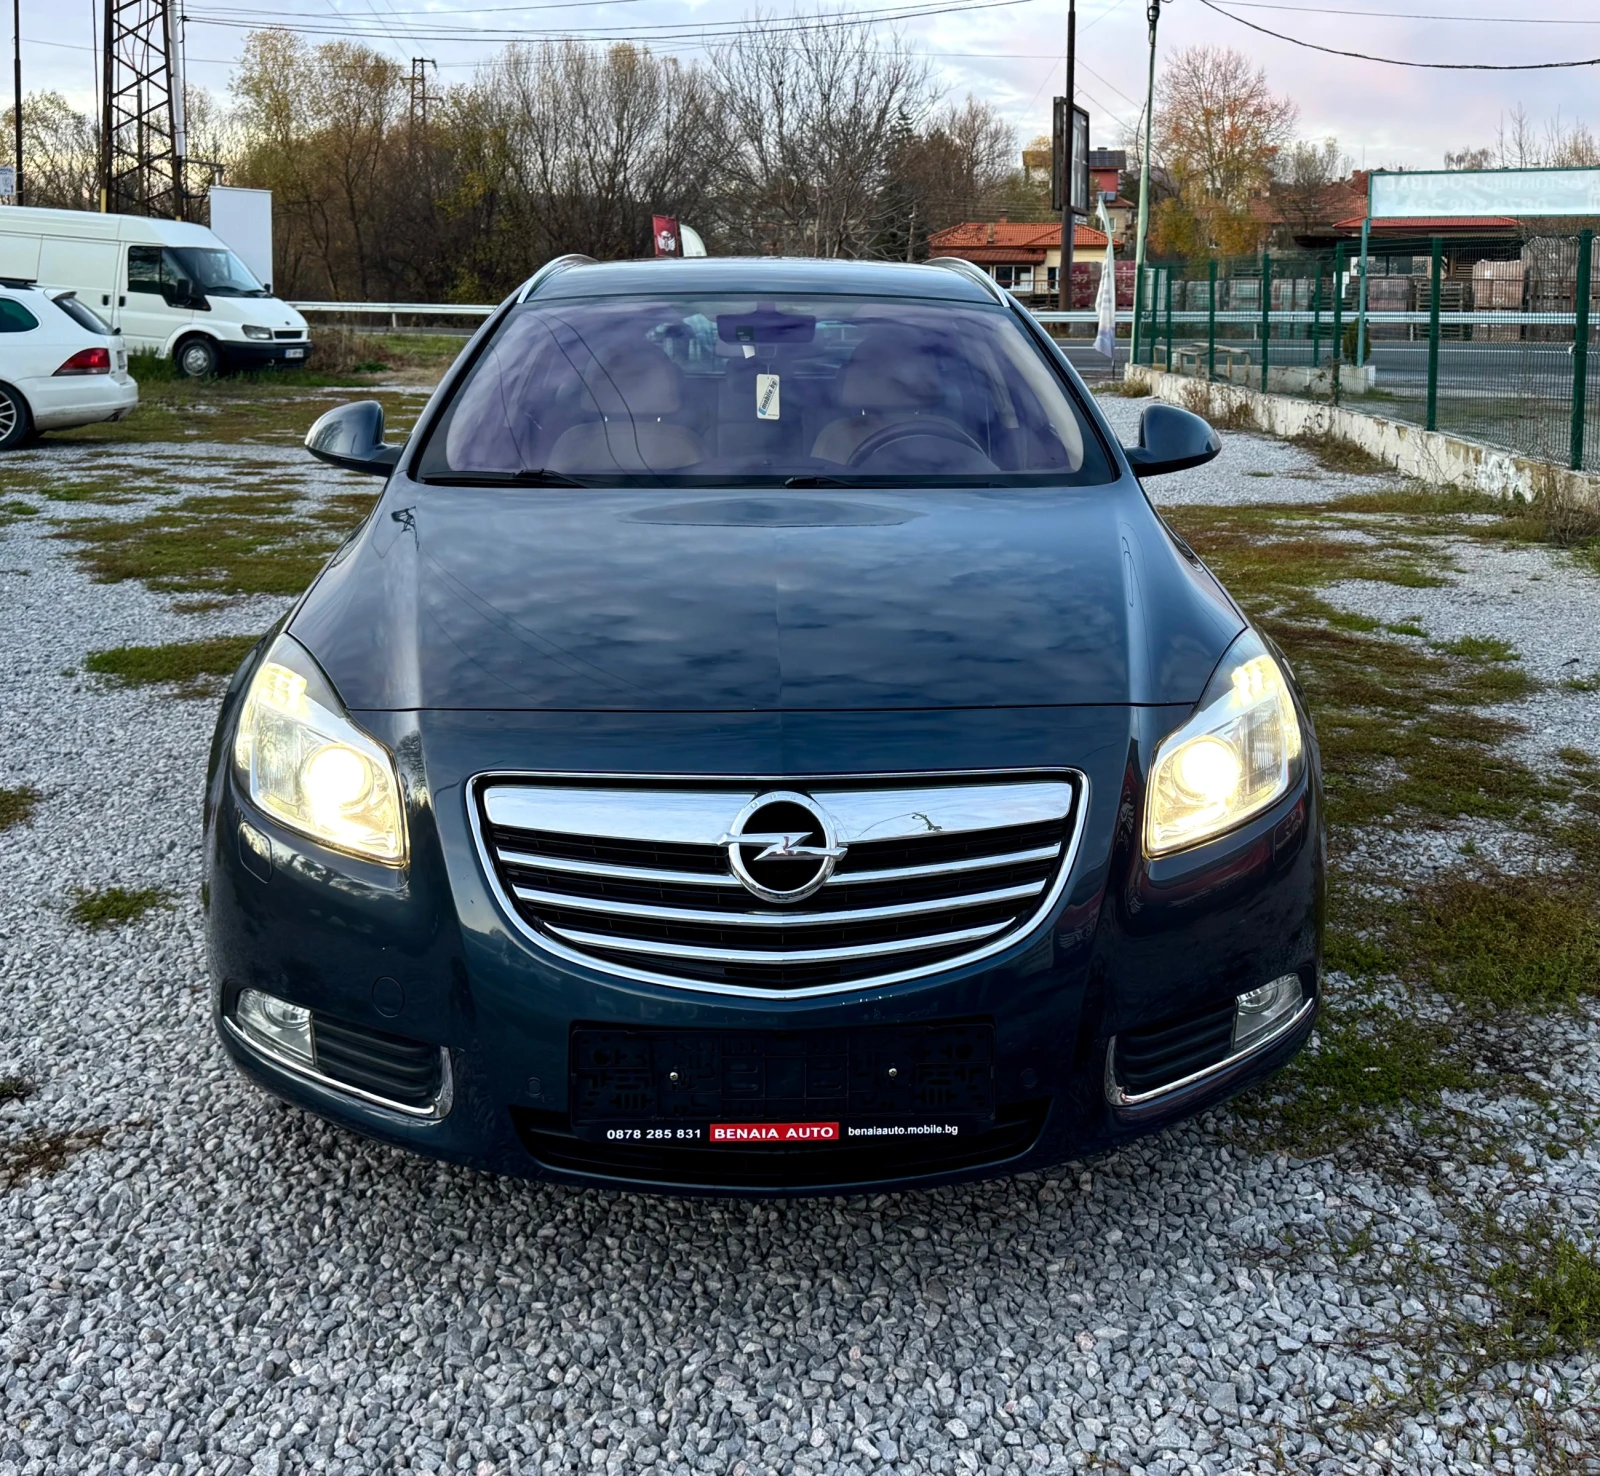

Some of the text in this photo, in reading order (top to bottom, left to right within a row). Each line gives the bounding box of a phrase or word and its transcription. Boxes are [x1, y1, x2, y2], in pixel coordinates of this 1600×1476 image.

[606, 1124, 959, 1139] 0878 285 831 BENAIA AUTO benaiaauto.mobile.bg
